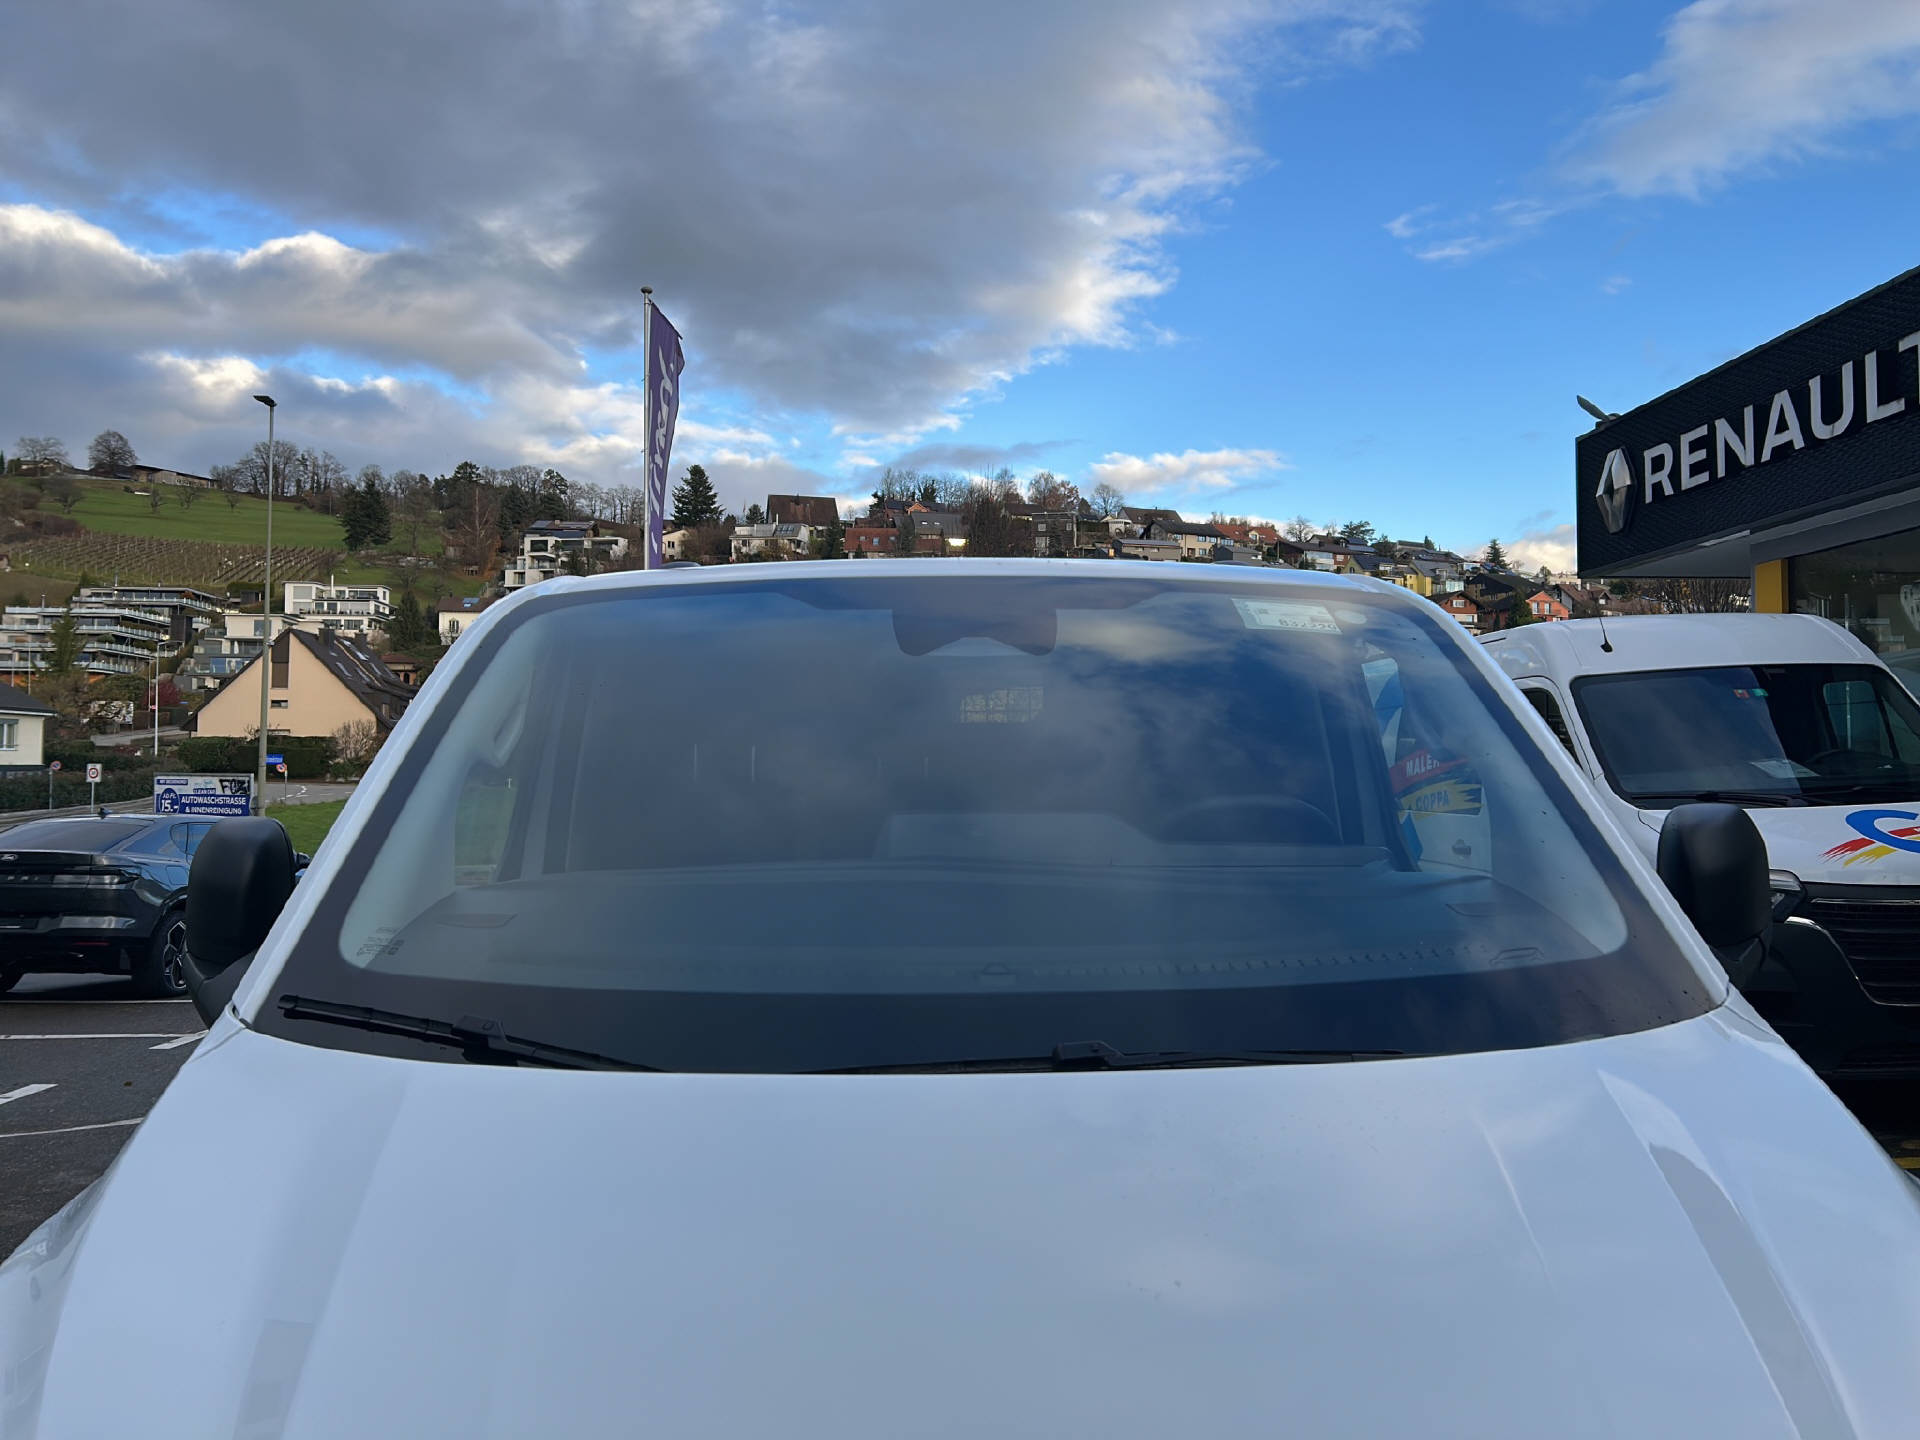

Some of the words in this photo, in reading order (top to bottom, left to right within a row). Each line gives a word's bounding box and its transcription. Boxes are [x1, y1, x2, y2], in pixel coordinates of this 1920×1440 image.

[181, 796, 246, 805] AUTOWASCHSTRASSE
[1415, 790, 1449, 810] COPPA
[191, 806, 242, 815] INNENREINIGUNG
